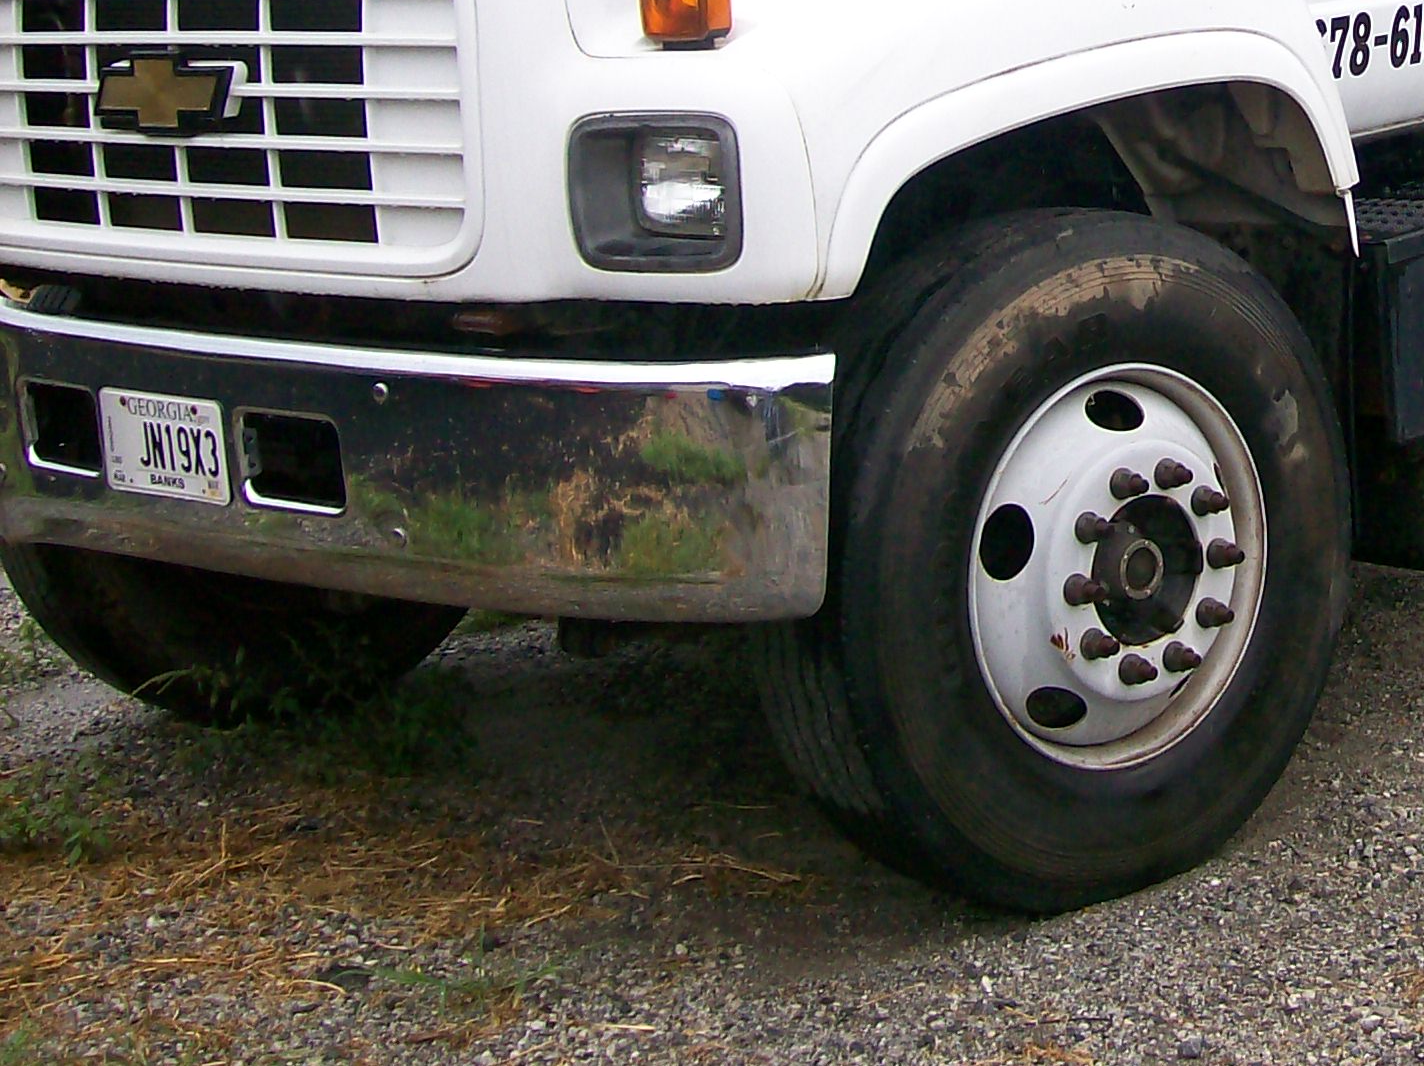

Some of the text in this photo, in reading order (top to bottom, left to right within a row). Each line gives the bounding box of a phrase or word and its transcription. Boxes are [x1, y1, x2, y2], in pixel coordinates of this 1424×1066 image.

[127, 397, 192, 421] GEORGIA
[140, 421, 219, 478] JN19X3
[150, 474, 185, 489] BANKS
